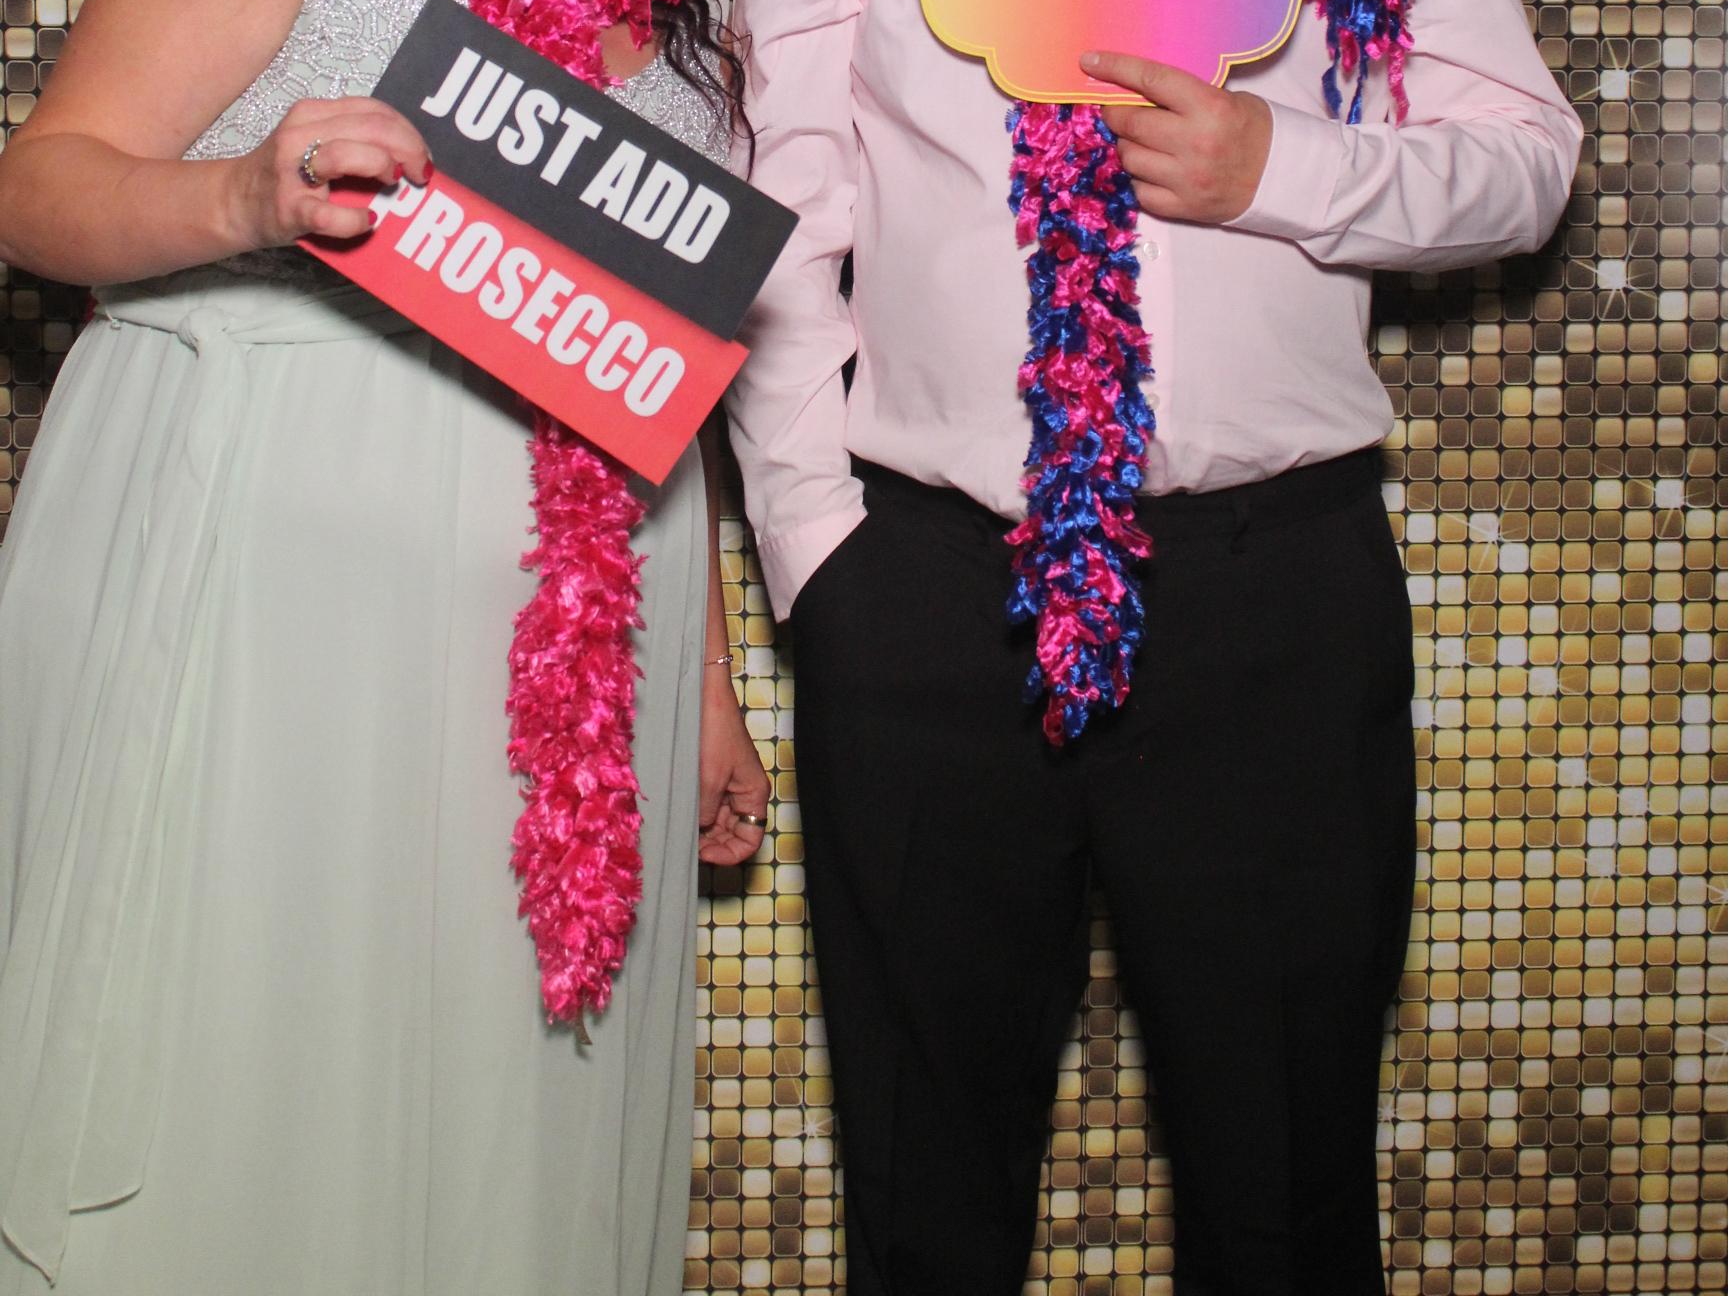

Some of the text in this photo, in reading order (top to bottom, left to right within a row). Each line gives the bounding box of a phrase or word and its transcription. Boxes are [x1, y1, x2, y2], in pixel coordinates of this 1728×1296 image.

[420, 46, 731, 265] JUST ADD
[367, 175, 686, 417] PROSECCO
